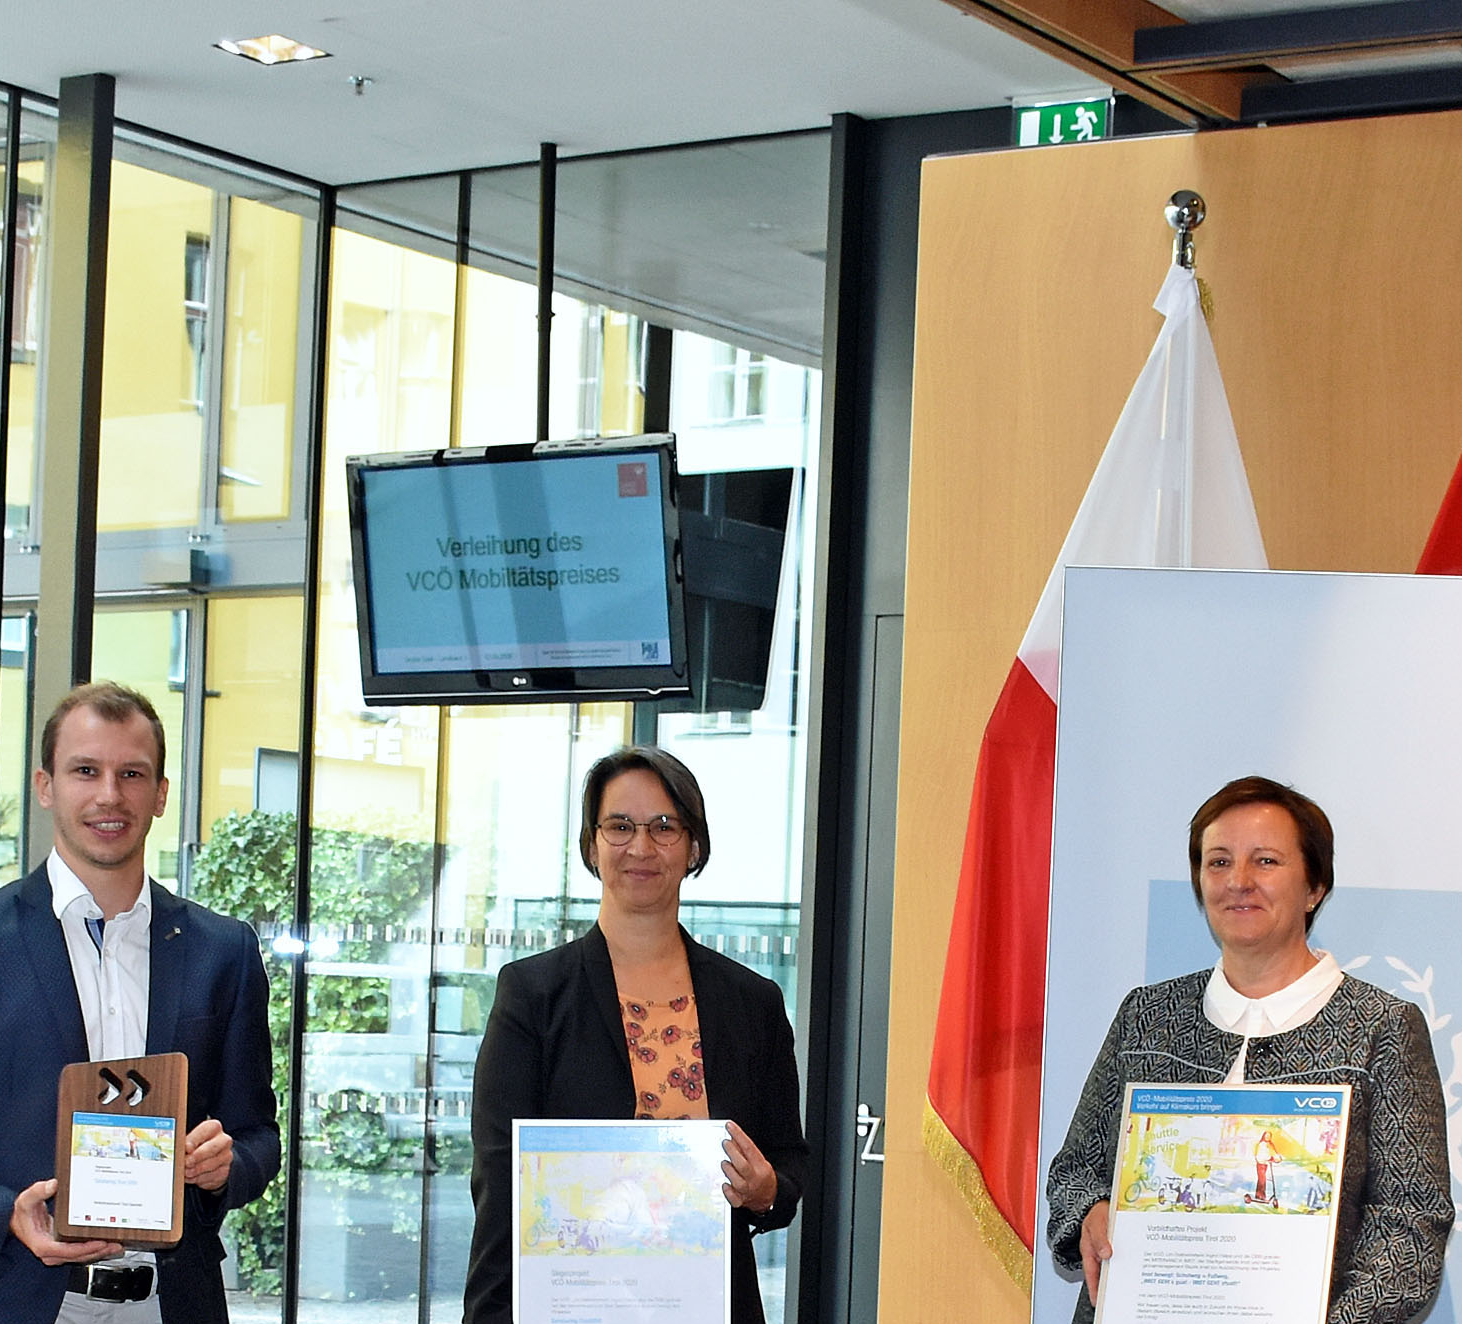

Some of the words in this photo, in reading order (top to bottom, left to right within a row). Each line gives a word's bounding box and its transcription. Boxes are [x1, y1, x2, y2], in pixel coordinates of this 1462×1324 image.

[436, 534, 540, 559] Verleihung
[546, 531, 583, 553] des
[405, 565, 453, 592] VCÖ
